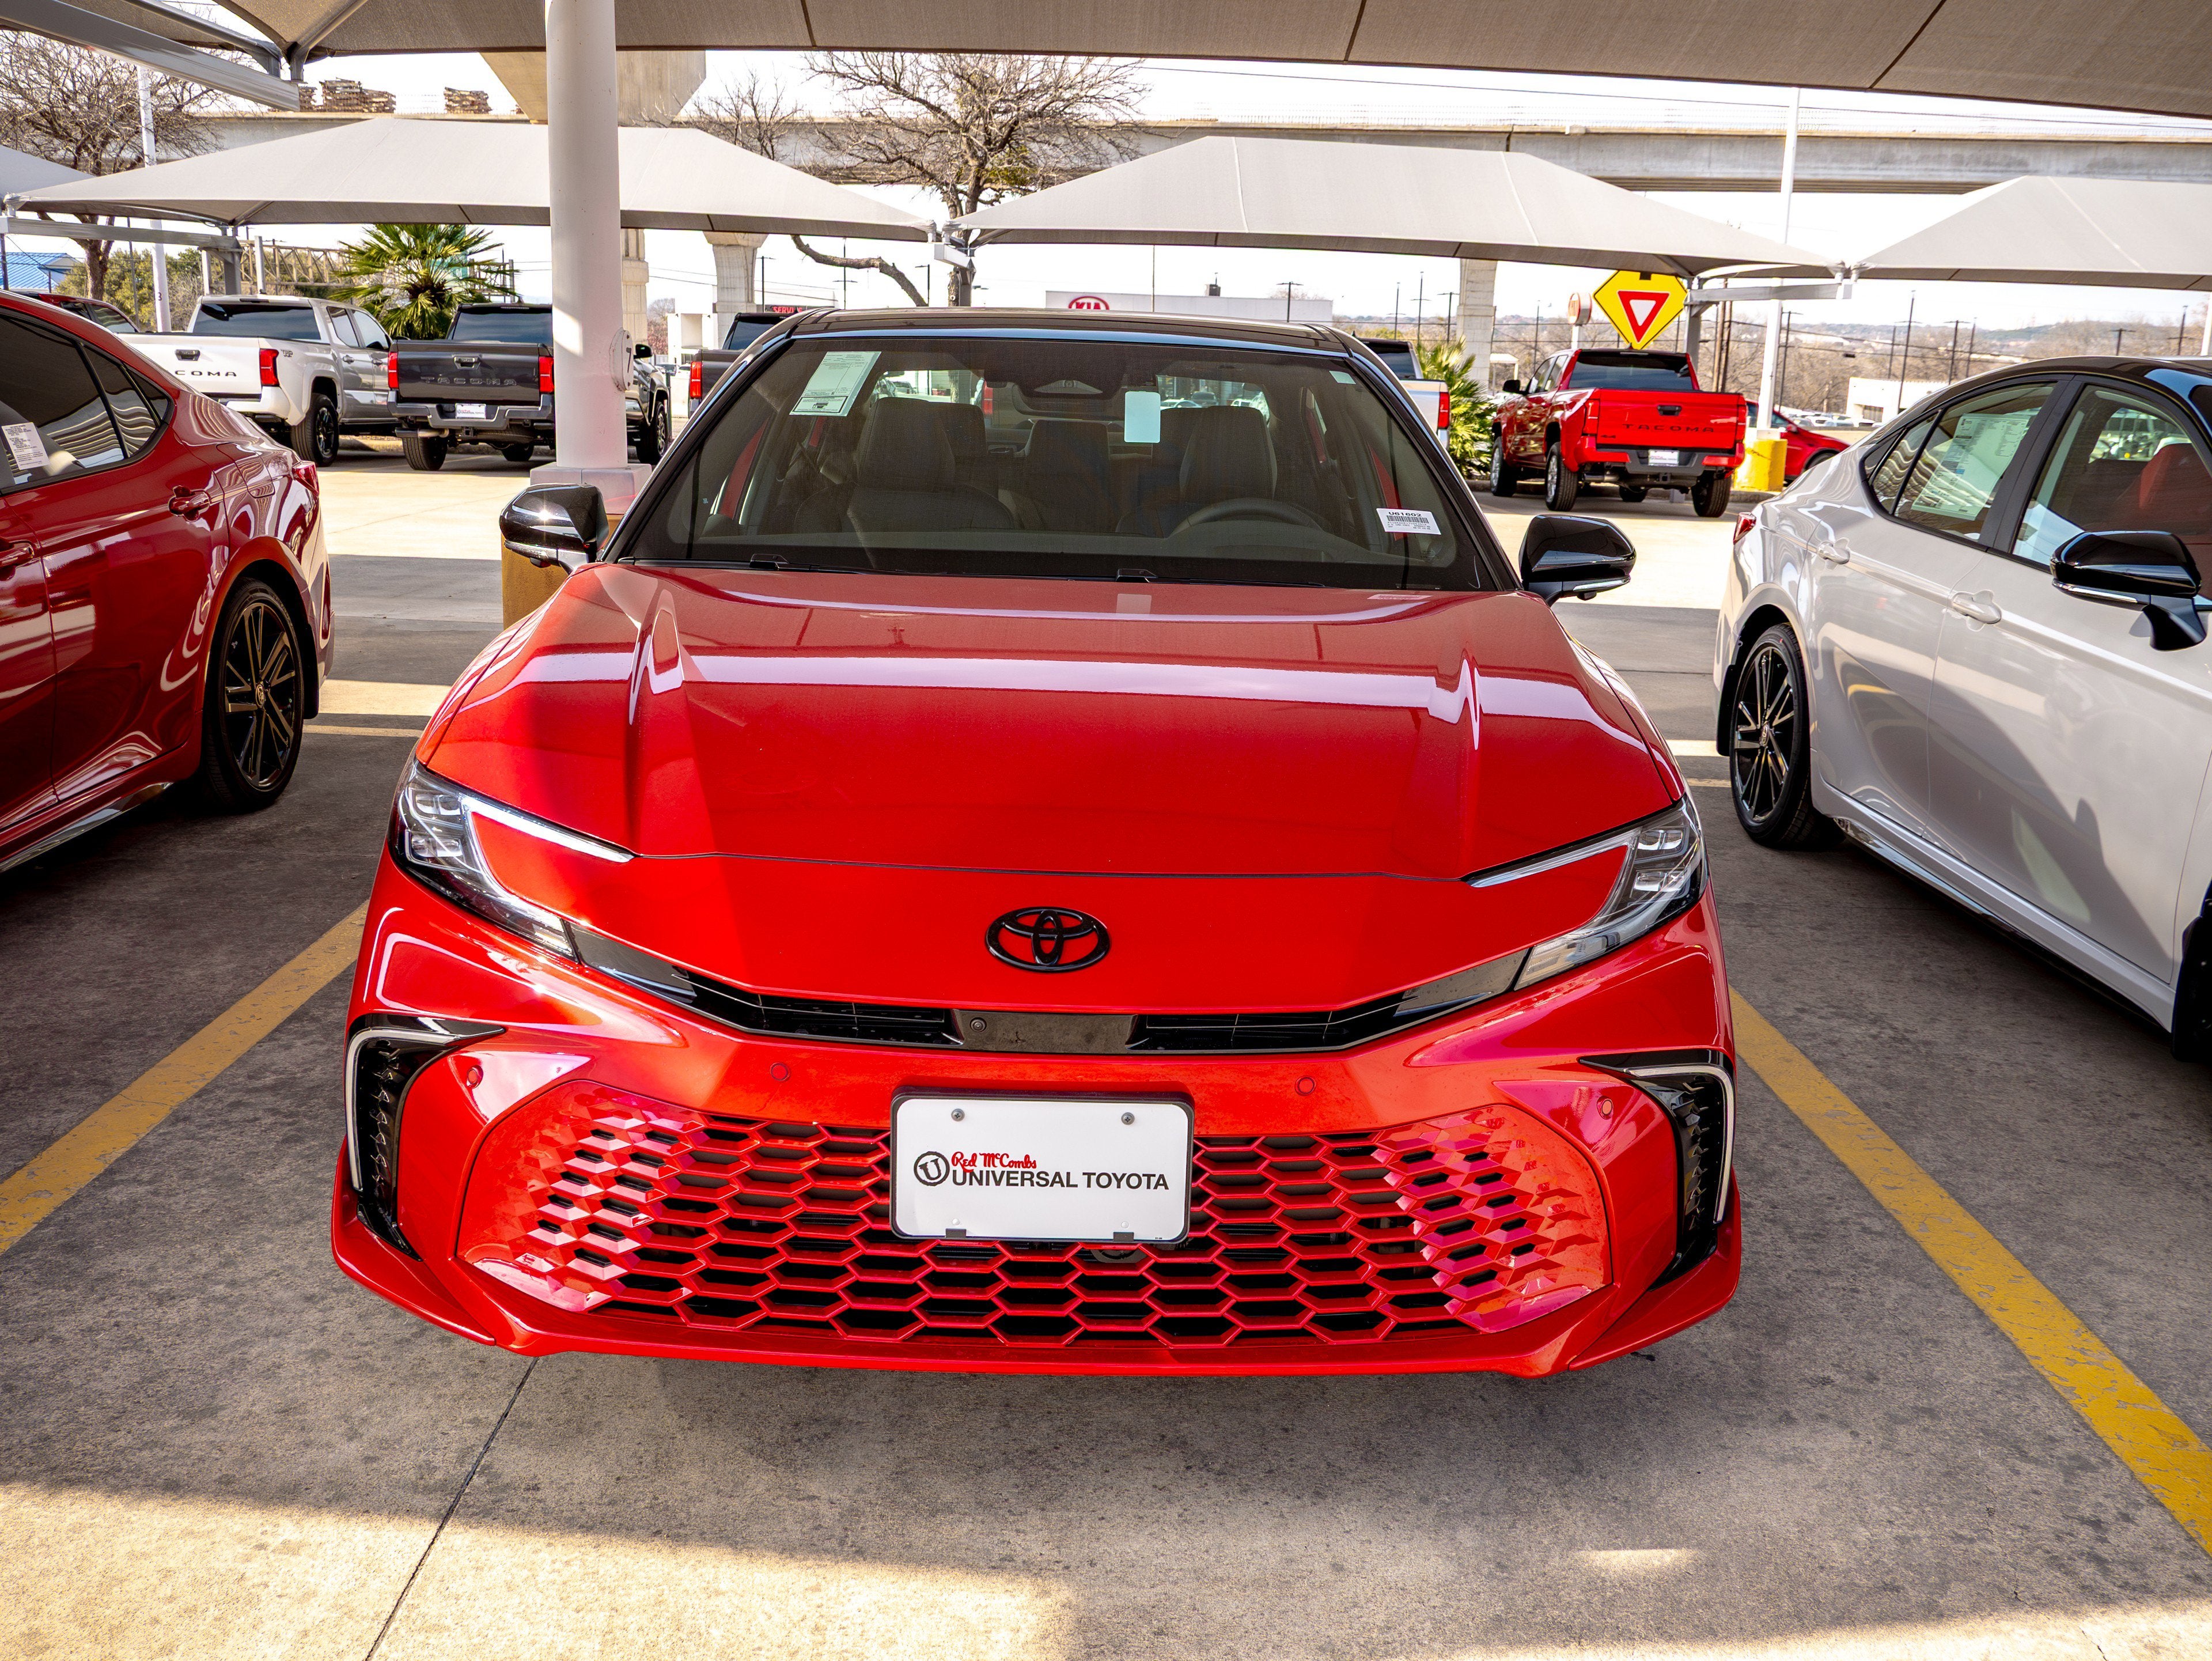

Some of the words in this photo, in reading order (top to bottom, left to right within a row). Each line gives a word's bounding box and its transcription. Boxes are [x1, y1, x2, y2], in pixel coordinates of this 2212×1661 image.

[158, 292, 162, 301] 3
[772, 306, 803, 314] SERVIE
[1075, 302, 1101, 310] KIA
[626, 347, 632, 373] 7
[421, 376, 517, 386] TACOMA
[1622, 423, 1714, 432] TACOMA
[951, 1152, 978, 1173] Red
[952, 1169, 1078, 1188] UNIVERSAL
[1082, 1172, 1169, 1190] TOYOTA
